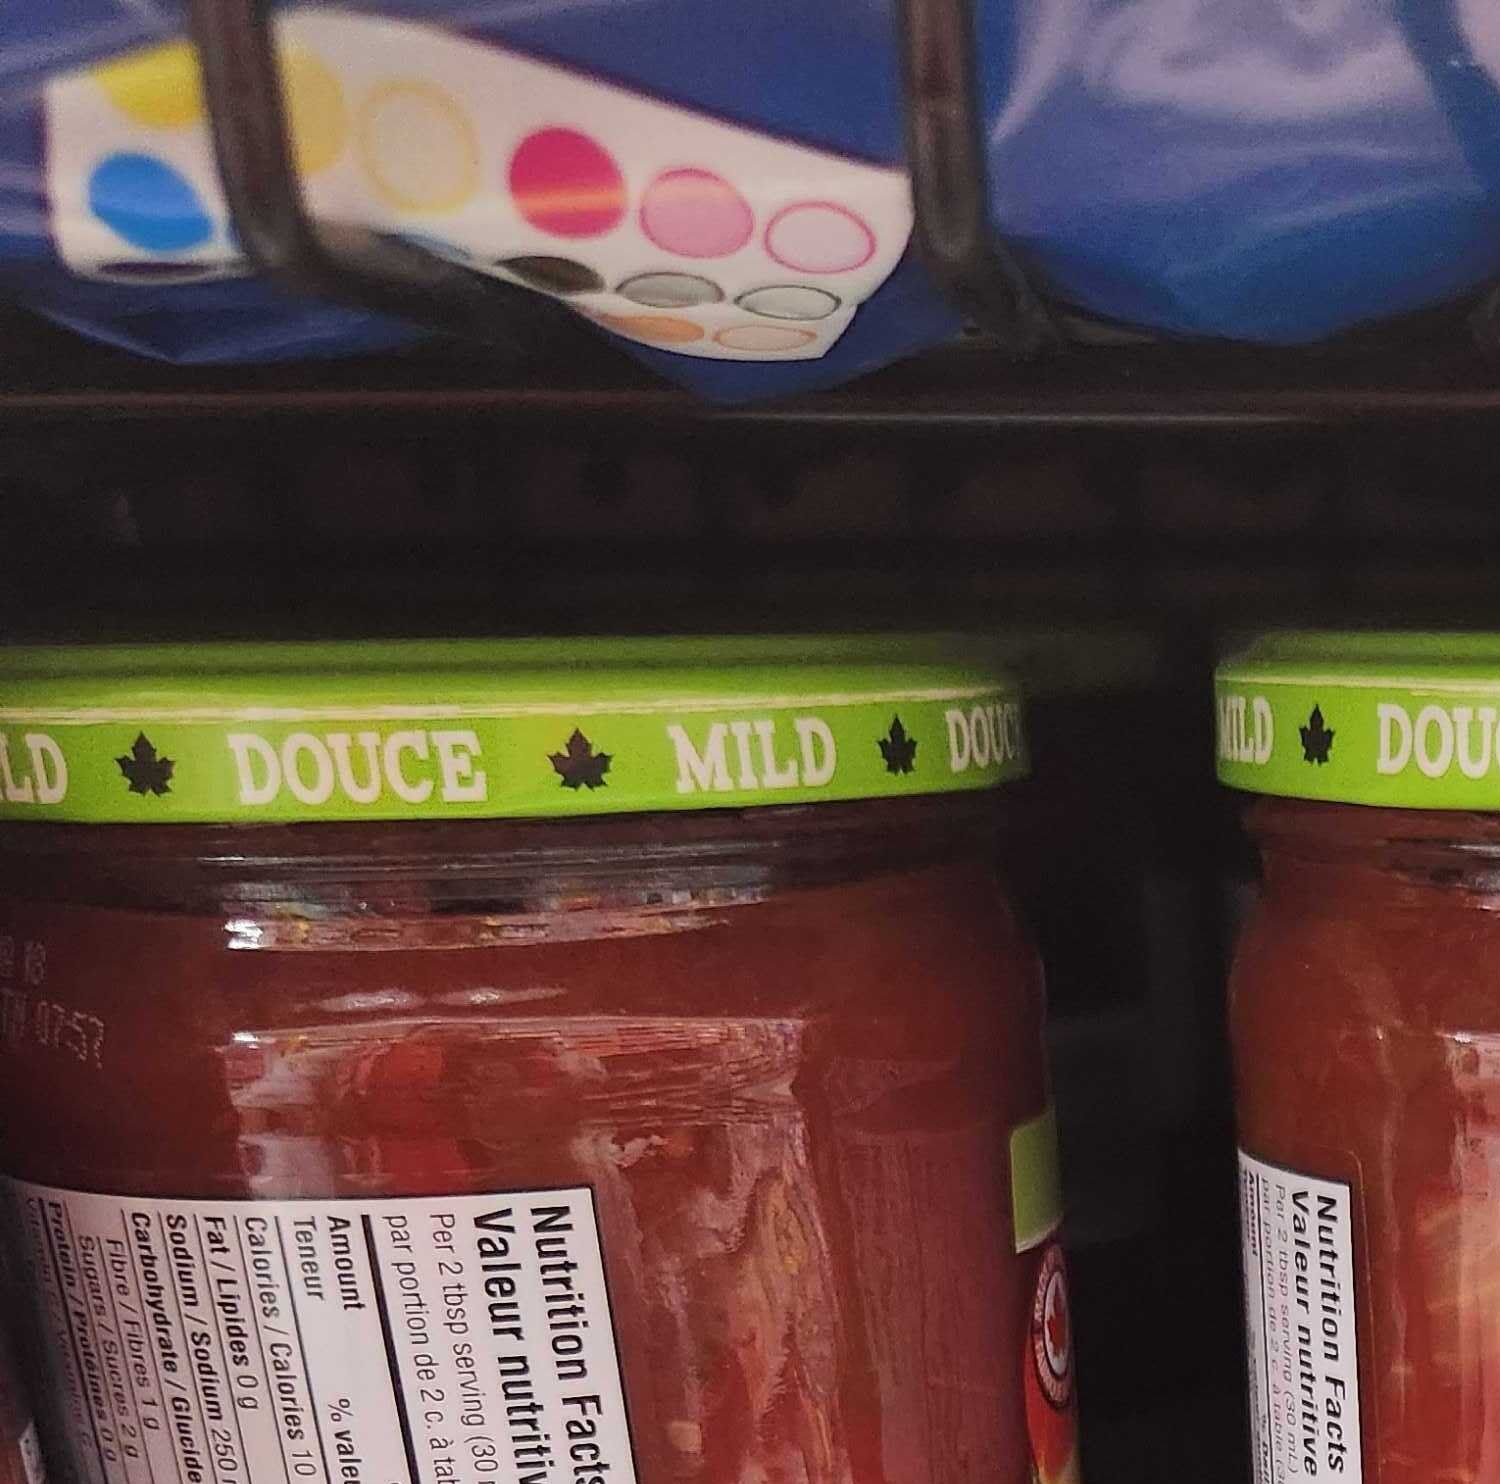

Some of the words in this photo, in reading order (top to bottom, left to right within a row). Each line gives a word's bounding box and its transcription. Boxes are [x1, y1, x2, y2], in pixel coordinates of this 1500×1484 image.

[227, 729, 489, 806] DOUCE
[668, 717, 838, 794] MILD
[945, 702, 1022, 773] DOUC
[49, 1201, 76, 1287] Protein
[203, 1215, 231, 1255] Fat
[293, 1219, 325, 1302] Teneur
[326, 1215, 366, 1311] Amount
[382, 1214, 414, 1253] par
[429, 1213, 456, 1253] Per
[438, 1261, 464, 1276] 2
[473, 1207, 525, 1342] Valeur
[1291, 1190, 1312, 1315] Valeur
[106, 1238, 130, 1297] Fibre
[123, 1319, 151, 1389] Fibres
[131, 1212, 179, 1374] Carbohydrate
[392, 1261, 430, 1346] portion
[442, 1285, 470, 1335] tbsp
[531, 1205, 589, 1381] Nutrition
[1317, 1193, 1343, 1362] Nutrition
[79, 1234, 107, 1317] Sugars
[102, 1338, 130, 1417] Sucres
[166, 1213, 200, 1308] Sodium
[190, 1332, 223, 1421] Sodium
[211, 1428, 238, 1472] 250
[215, 1278, 251, 1367] Lipides
[244, 1216, 281, 1319] Calories
[270, 1341, 306, 1442] Calories
[292, 1449, 317, 1477] 10
[236, 1375, 259, 1390] 0
[237, 1399, 259, 1411] g
[413, 1352, 440, 1382] de
[420, 1388, 445, 1403] 2
[453, 1342, 487, 1427] serving
[1297, 1323, 1320, 1478] nutritive
[327, 1398, 354, 1423] %
[424, 1410, 444, 1430] c.
[429, 1436, 455, 1450] à
[1324, 1375, 1348, 1475] Facts
[463, 1435, 499, 1473] (30
